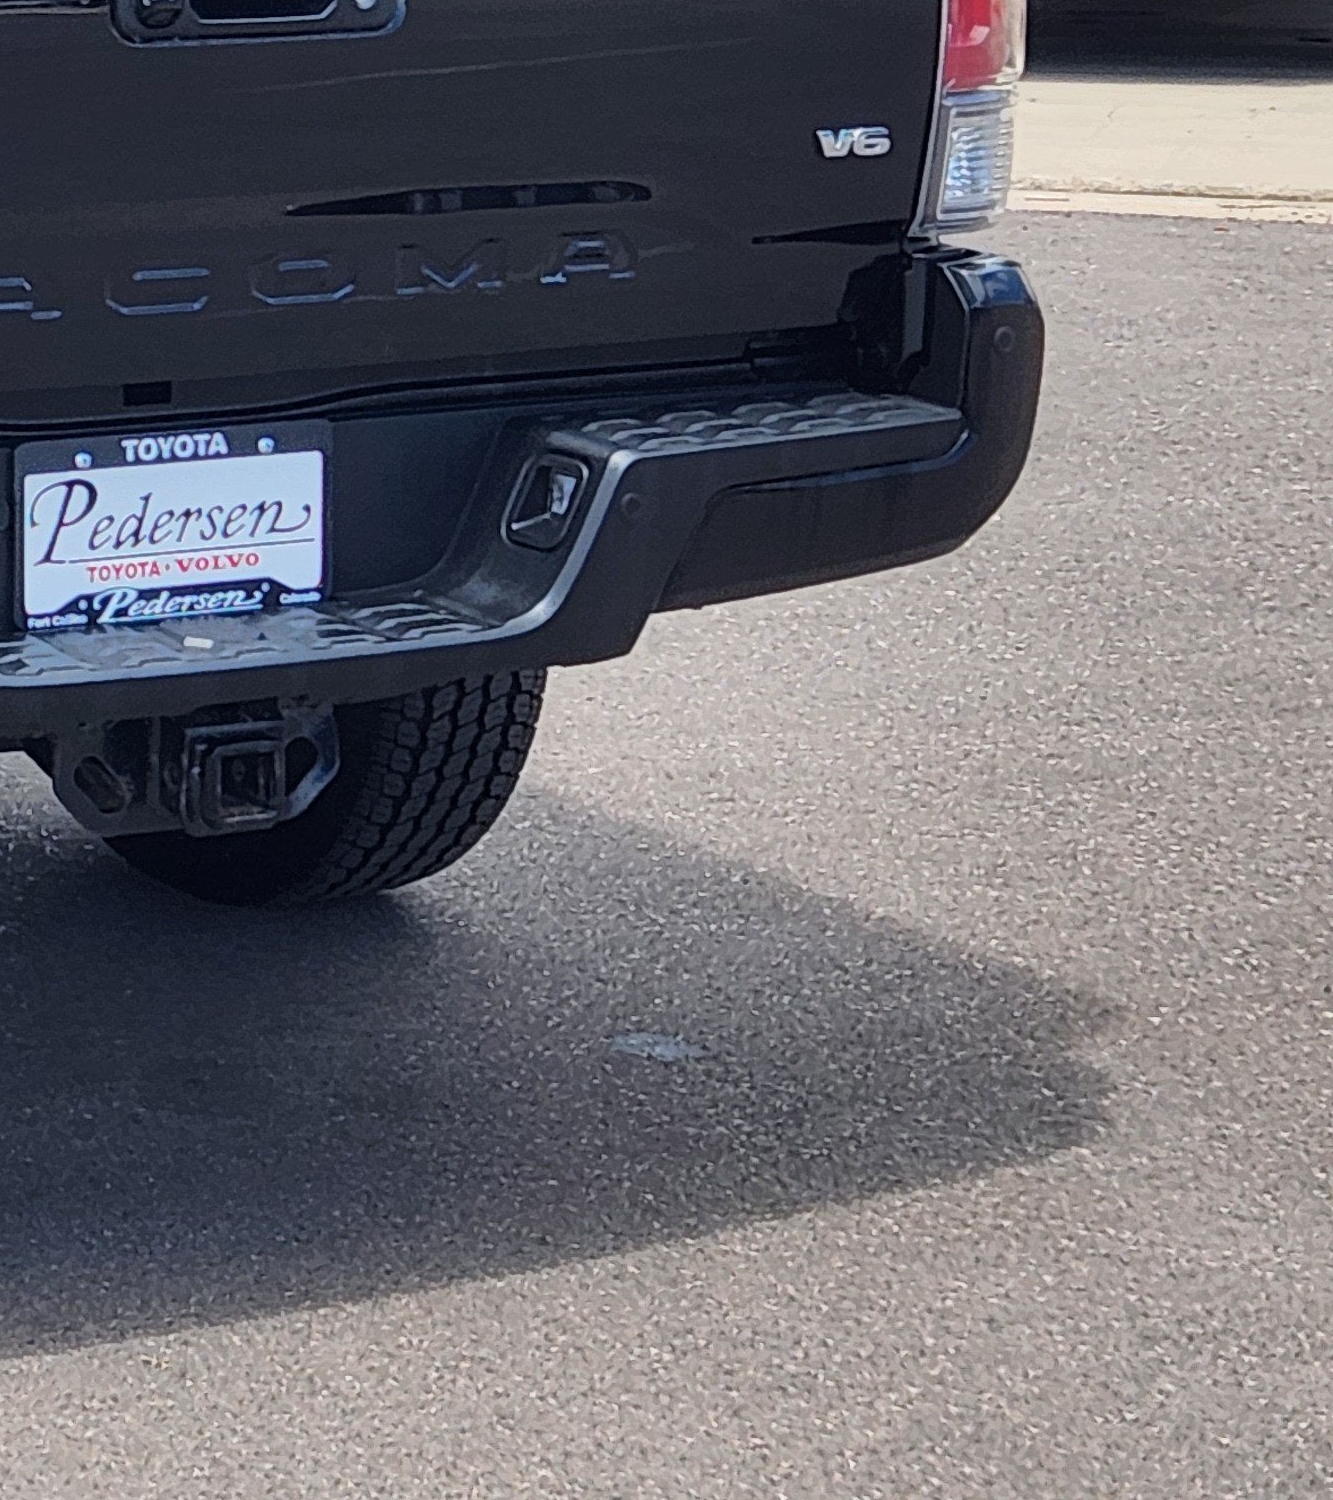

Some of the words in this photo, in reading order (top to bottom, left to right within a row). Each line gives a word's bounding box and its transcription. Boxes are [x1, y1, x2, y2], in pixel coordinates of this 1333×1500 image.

[815, 126, 892, 158] V6
[121, 432, 230, 463] TOYOTA
[30, 478, 313, 567] Pedersen
[86, 555, 161, 584] TOYOTA
[175, 551, 261, 574] VOLVO
[93, 587, 264, 624] Pedersen
